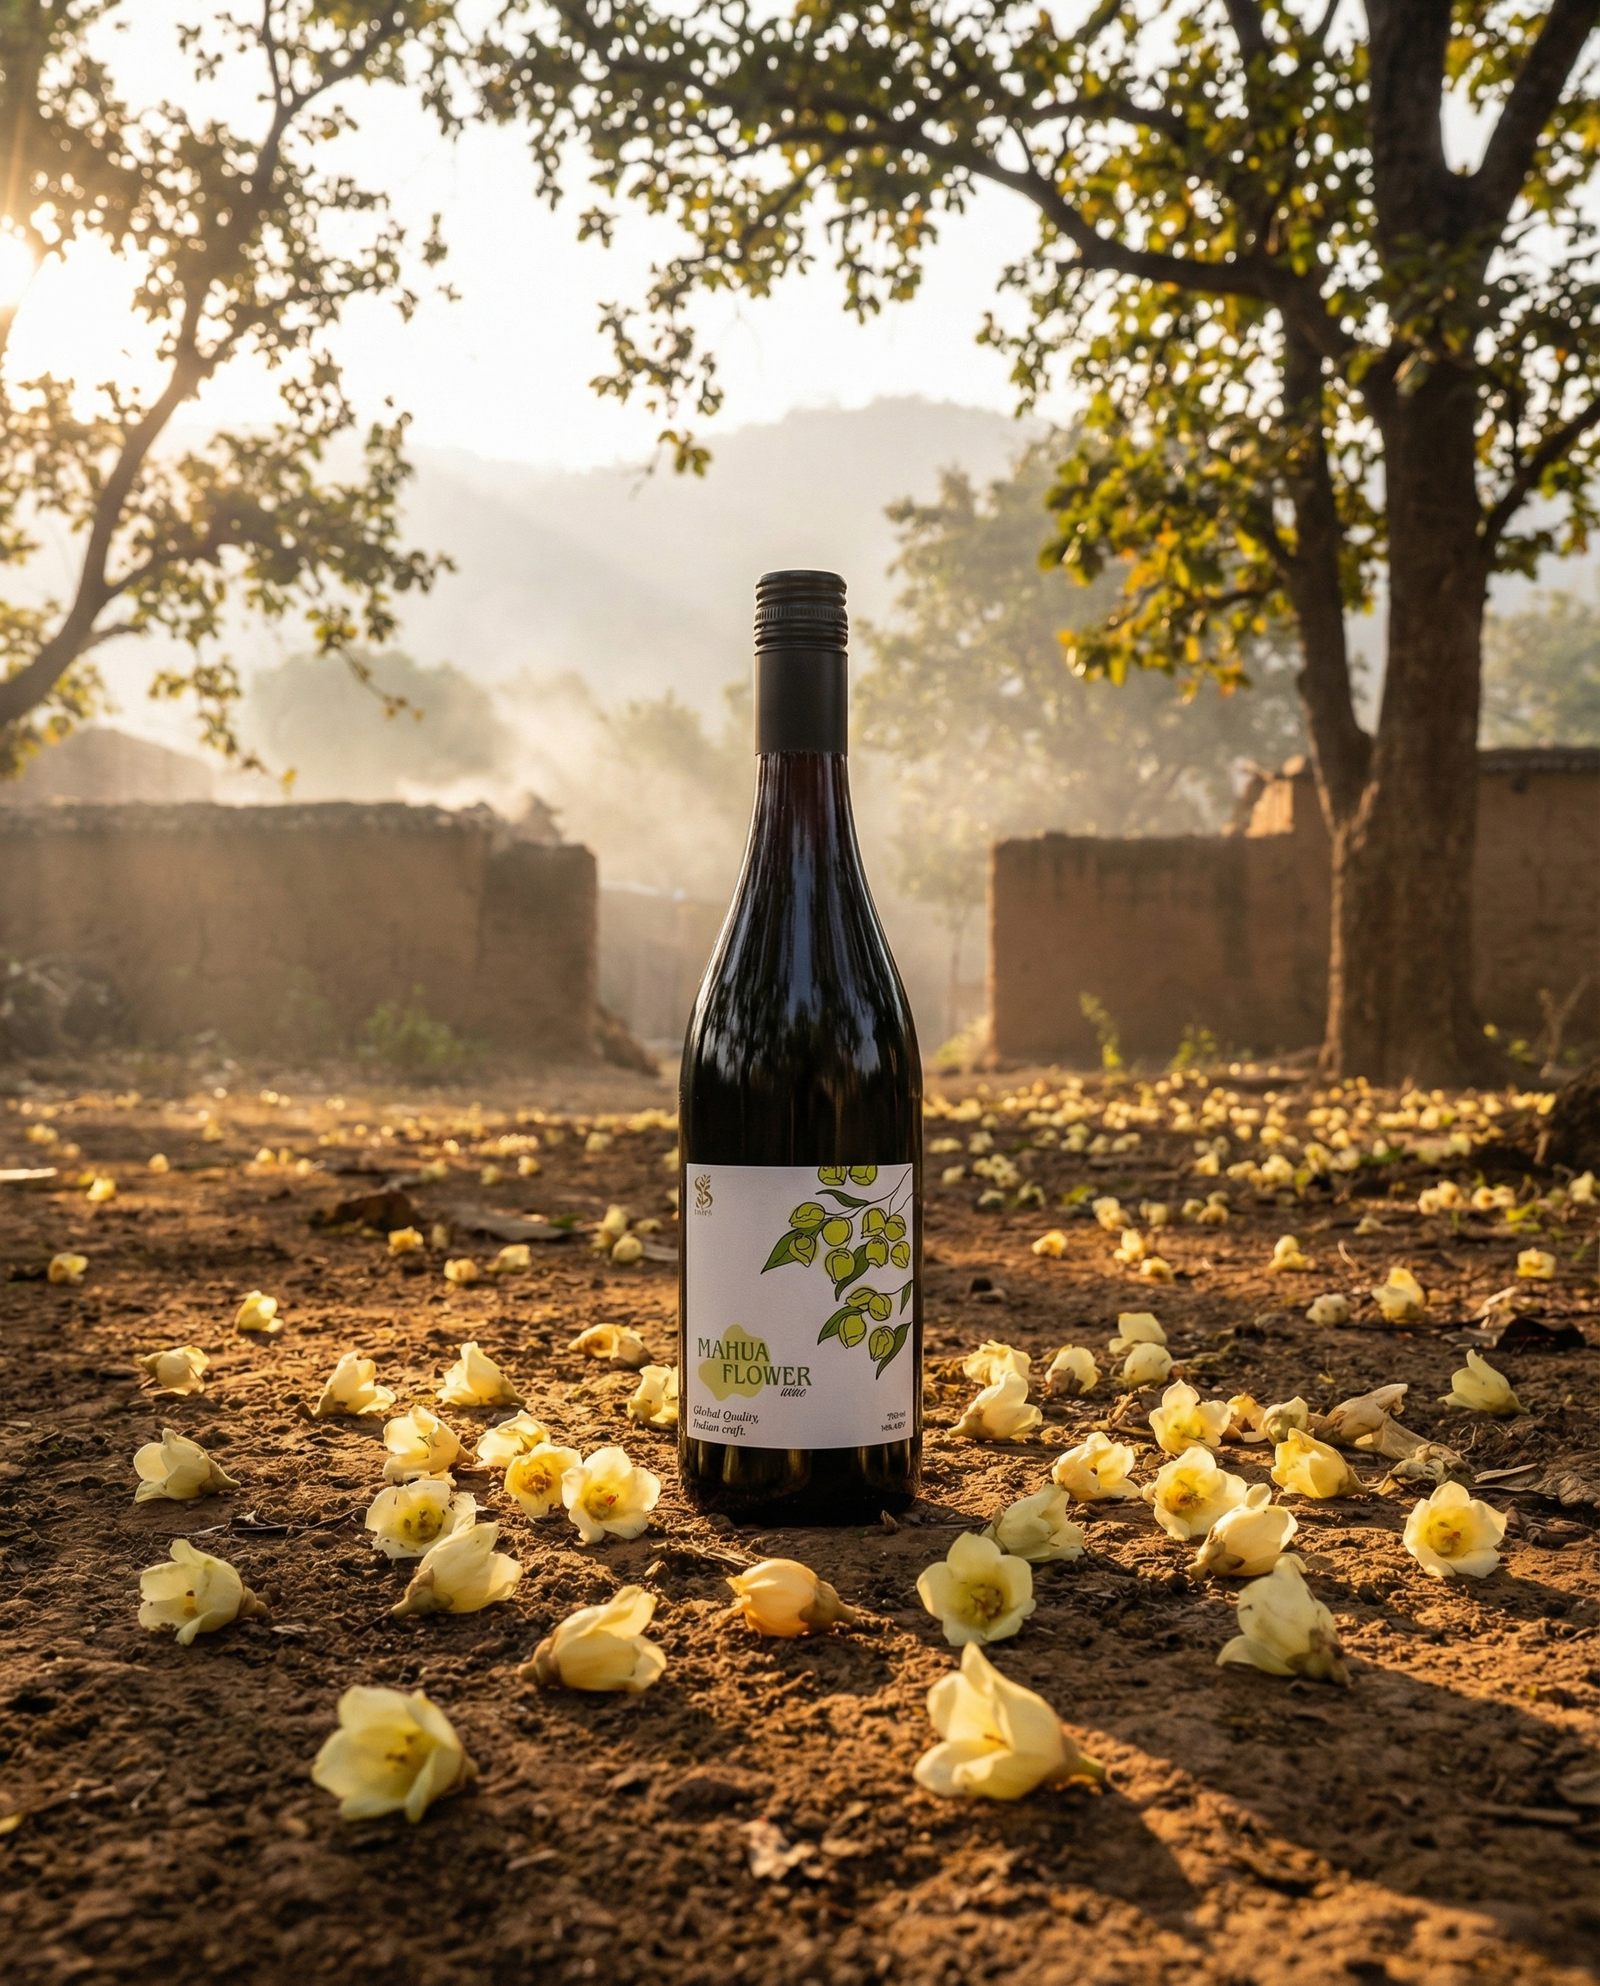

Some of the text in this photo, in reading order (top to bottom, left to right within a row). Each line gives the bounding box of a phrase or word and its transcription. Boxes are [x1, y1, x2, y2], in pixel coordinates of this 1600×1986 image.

[698, 1338, 770, 1362] MAHUA
[723, 1364, 812, 1386] FLOWER
[693, 1418, 746, 1437] Indian craft.
